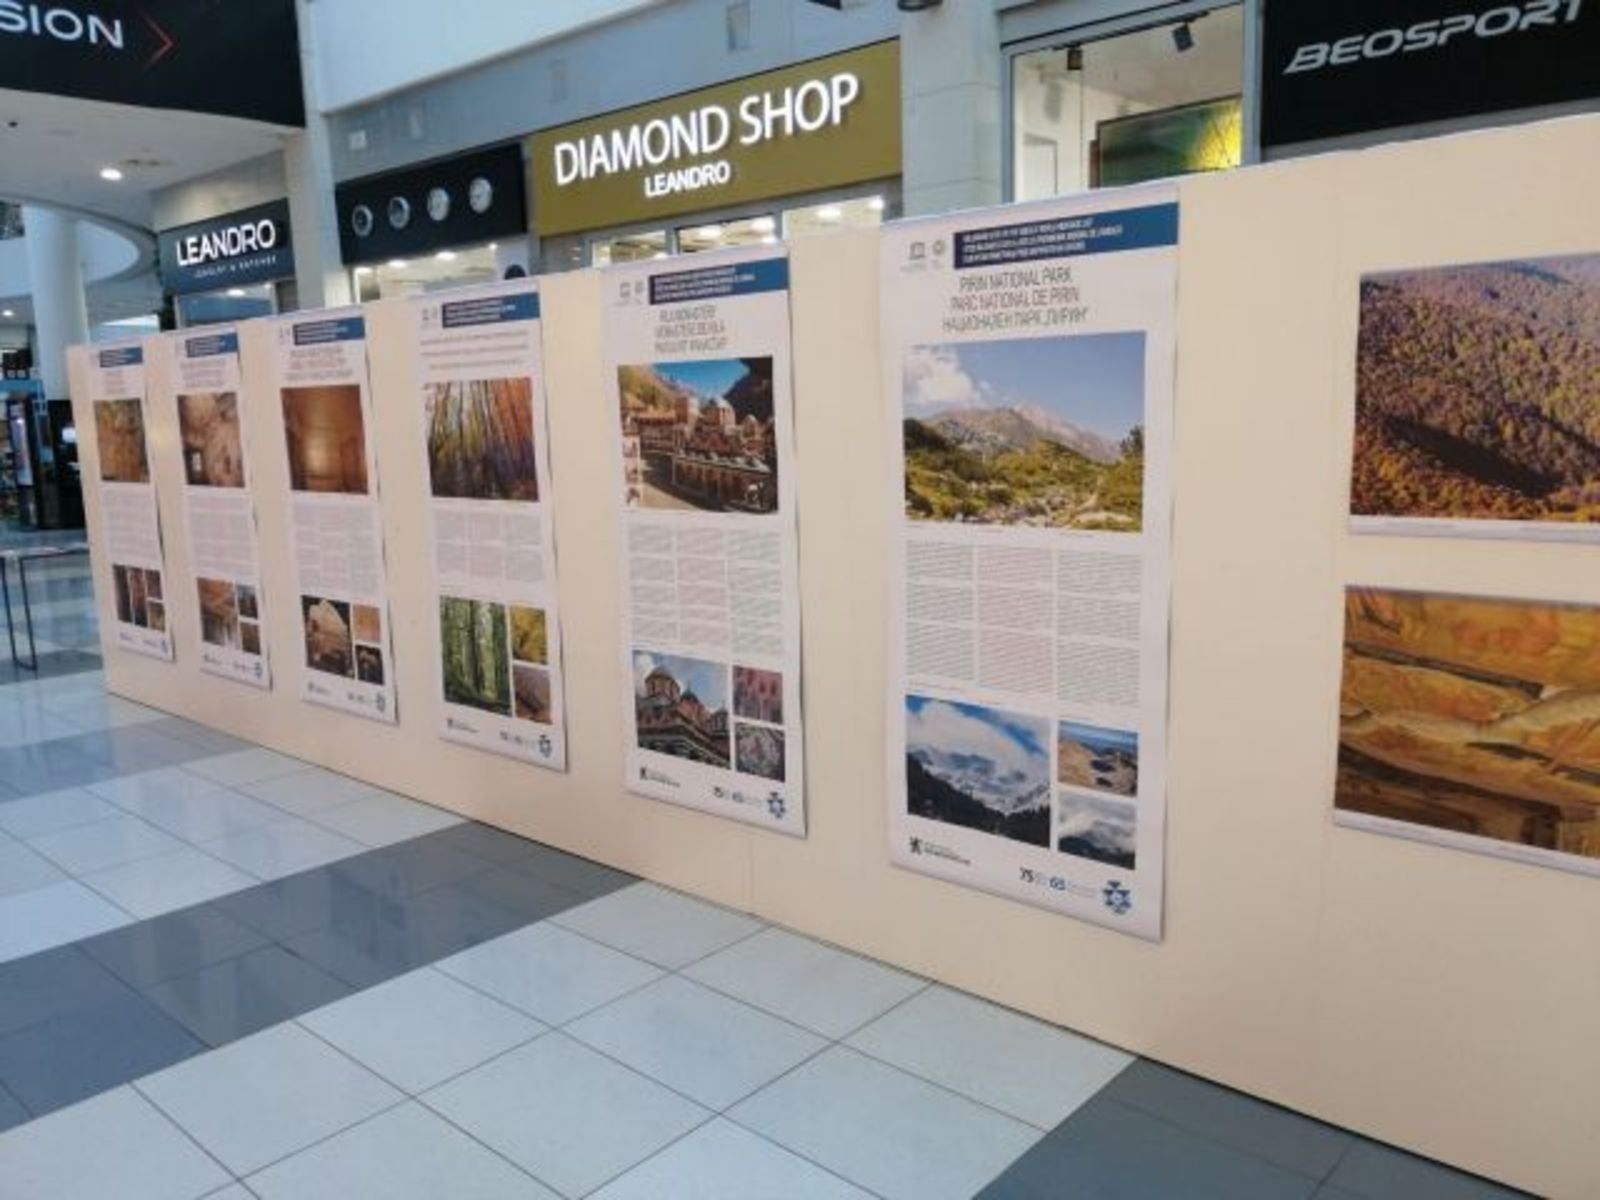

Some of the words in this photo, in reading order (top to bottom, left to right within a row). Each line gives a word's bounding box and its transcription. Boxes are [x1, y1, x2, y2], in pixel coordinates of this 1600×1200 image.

[0, 2, 124, 49] SION
[554, 104, 730, 187] DIAMOND
[739, 72, 859, 145] SHOP
[643, 160, 731, 197] LEANDRO
[176, 218, 276, 267] LEANDRO
